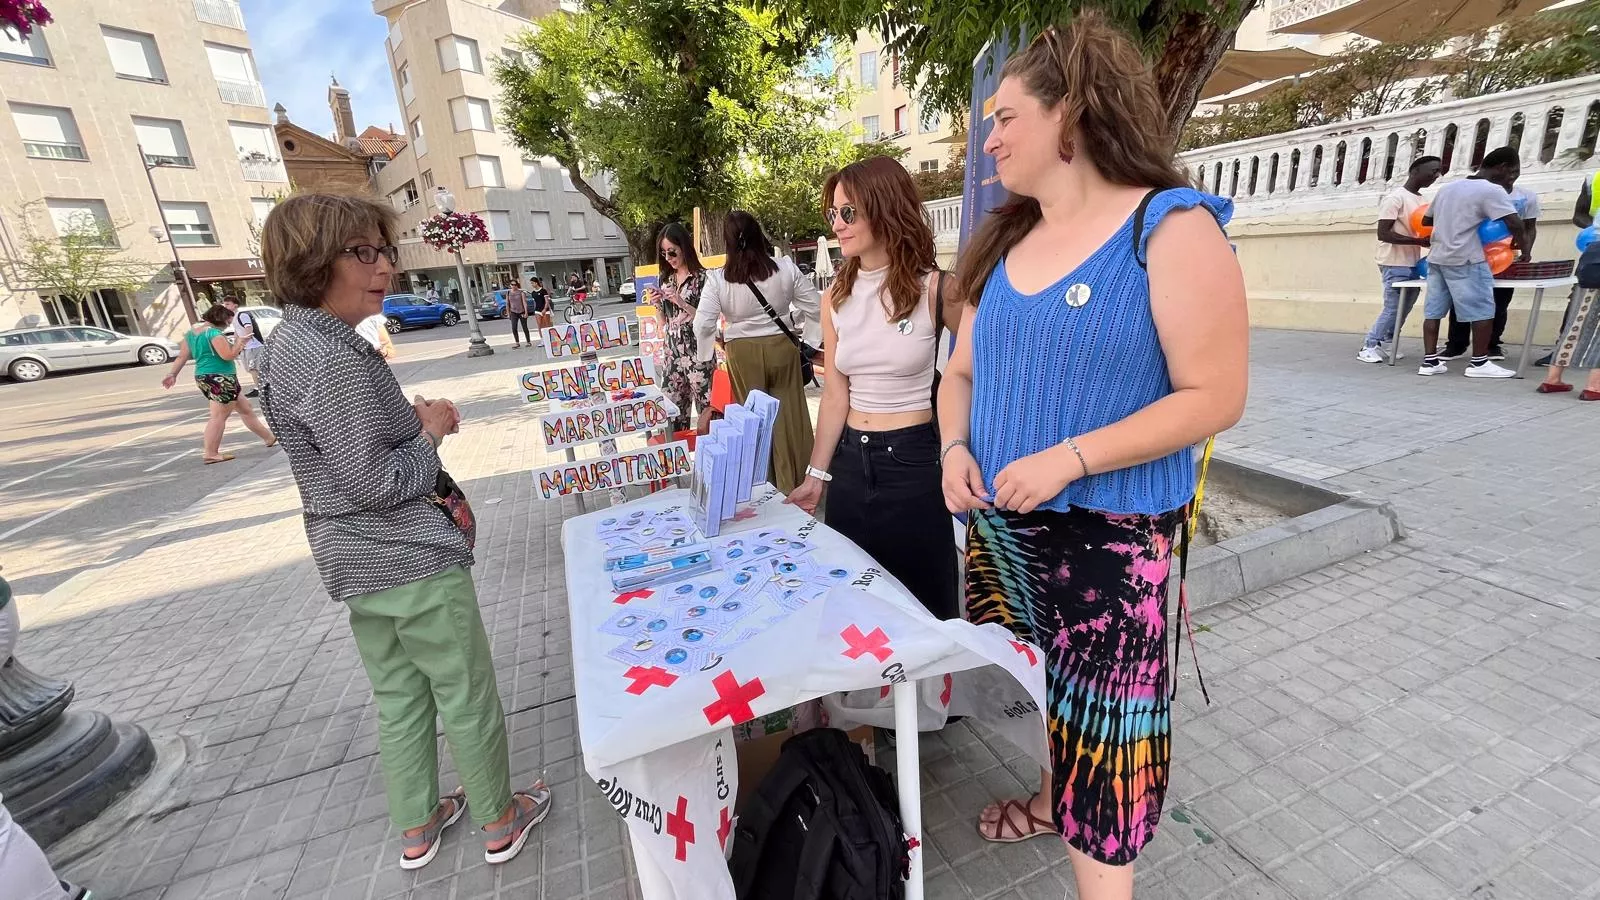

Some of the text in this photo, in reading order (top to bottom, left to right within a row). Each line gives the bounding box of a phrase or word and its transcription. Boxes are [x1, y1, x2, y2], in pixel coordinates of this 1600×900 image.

[549, 317, 629, 357] MALI
[522, 358, 655, 402] SENEGAL
[543, 396, 669, 446] MARRUECOS
[539, 446, 691, 499] MAURITANIA
[851, 567, 882, 586] Roja
[635, 796, 662, 835] Cruz
